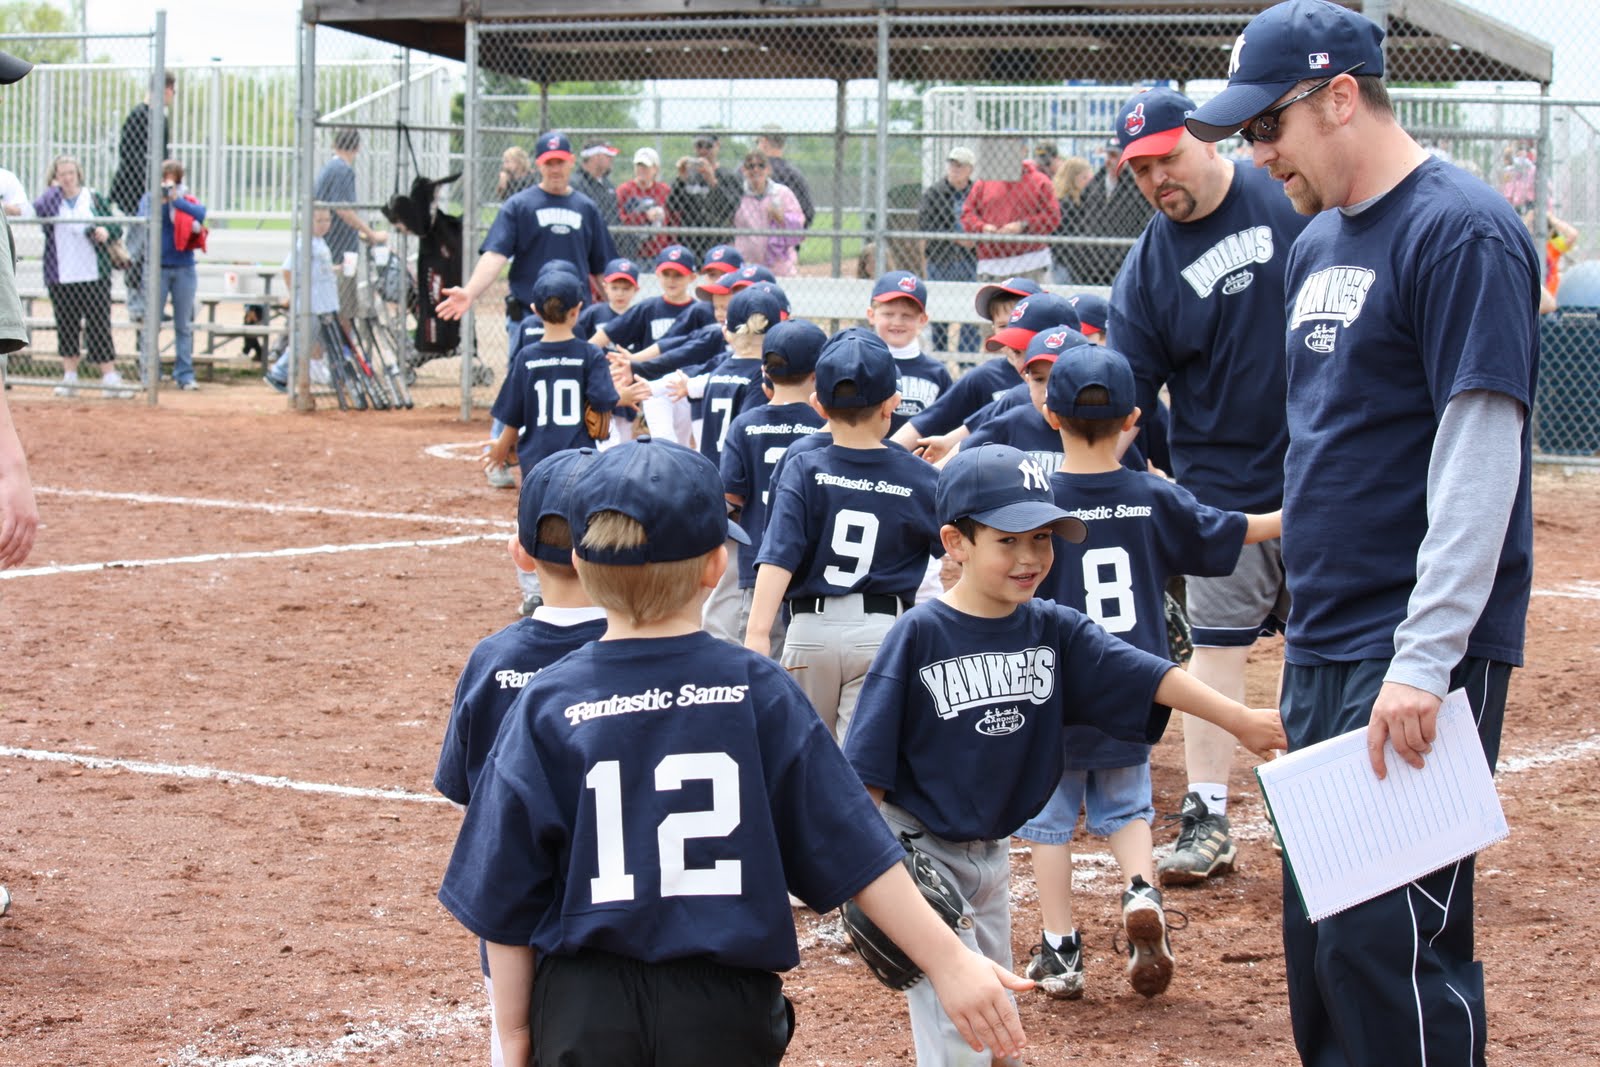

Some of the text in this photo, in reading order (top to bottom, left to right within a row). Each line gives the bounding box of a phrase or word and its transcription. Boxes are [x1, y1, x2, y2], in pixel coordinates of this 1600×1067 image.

[1180, 225, 1274, 298] INDIANS
[534, 379, 580, 426] 10
[900, 375, 940, 409] IANS
[711, 397, 733, 452] 7
[792, 423, 818, 435] Sam
[814, 472, 912, 497] Fantastic Sams
[1114, 504, 1152, 518] Sams
[823, 508, 880, 588] 9
[1081, 546, 1138, 633] 8
[495, 668, 543, 689] Fan
[918, 645, 1056, 721] YANKEES
[564, 684, 749, 726] Fantastic Sams
[586, 752, 742, 904] 12
